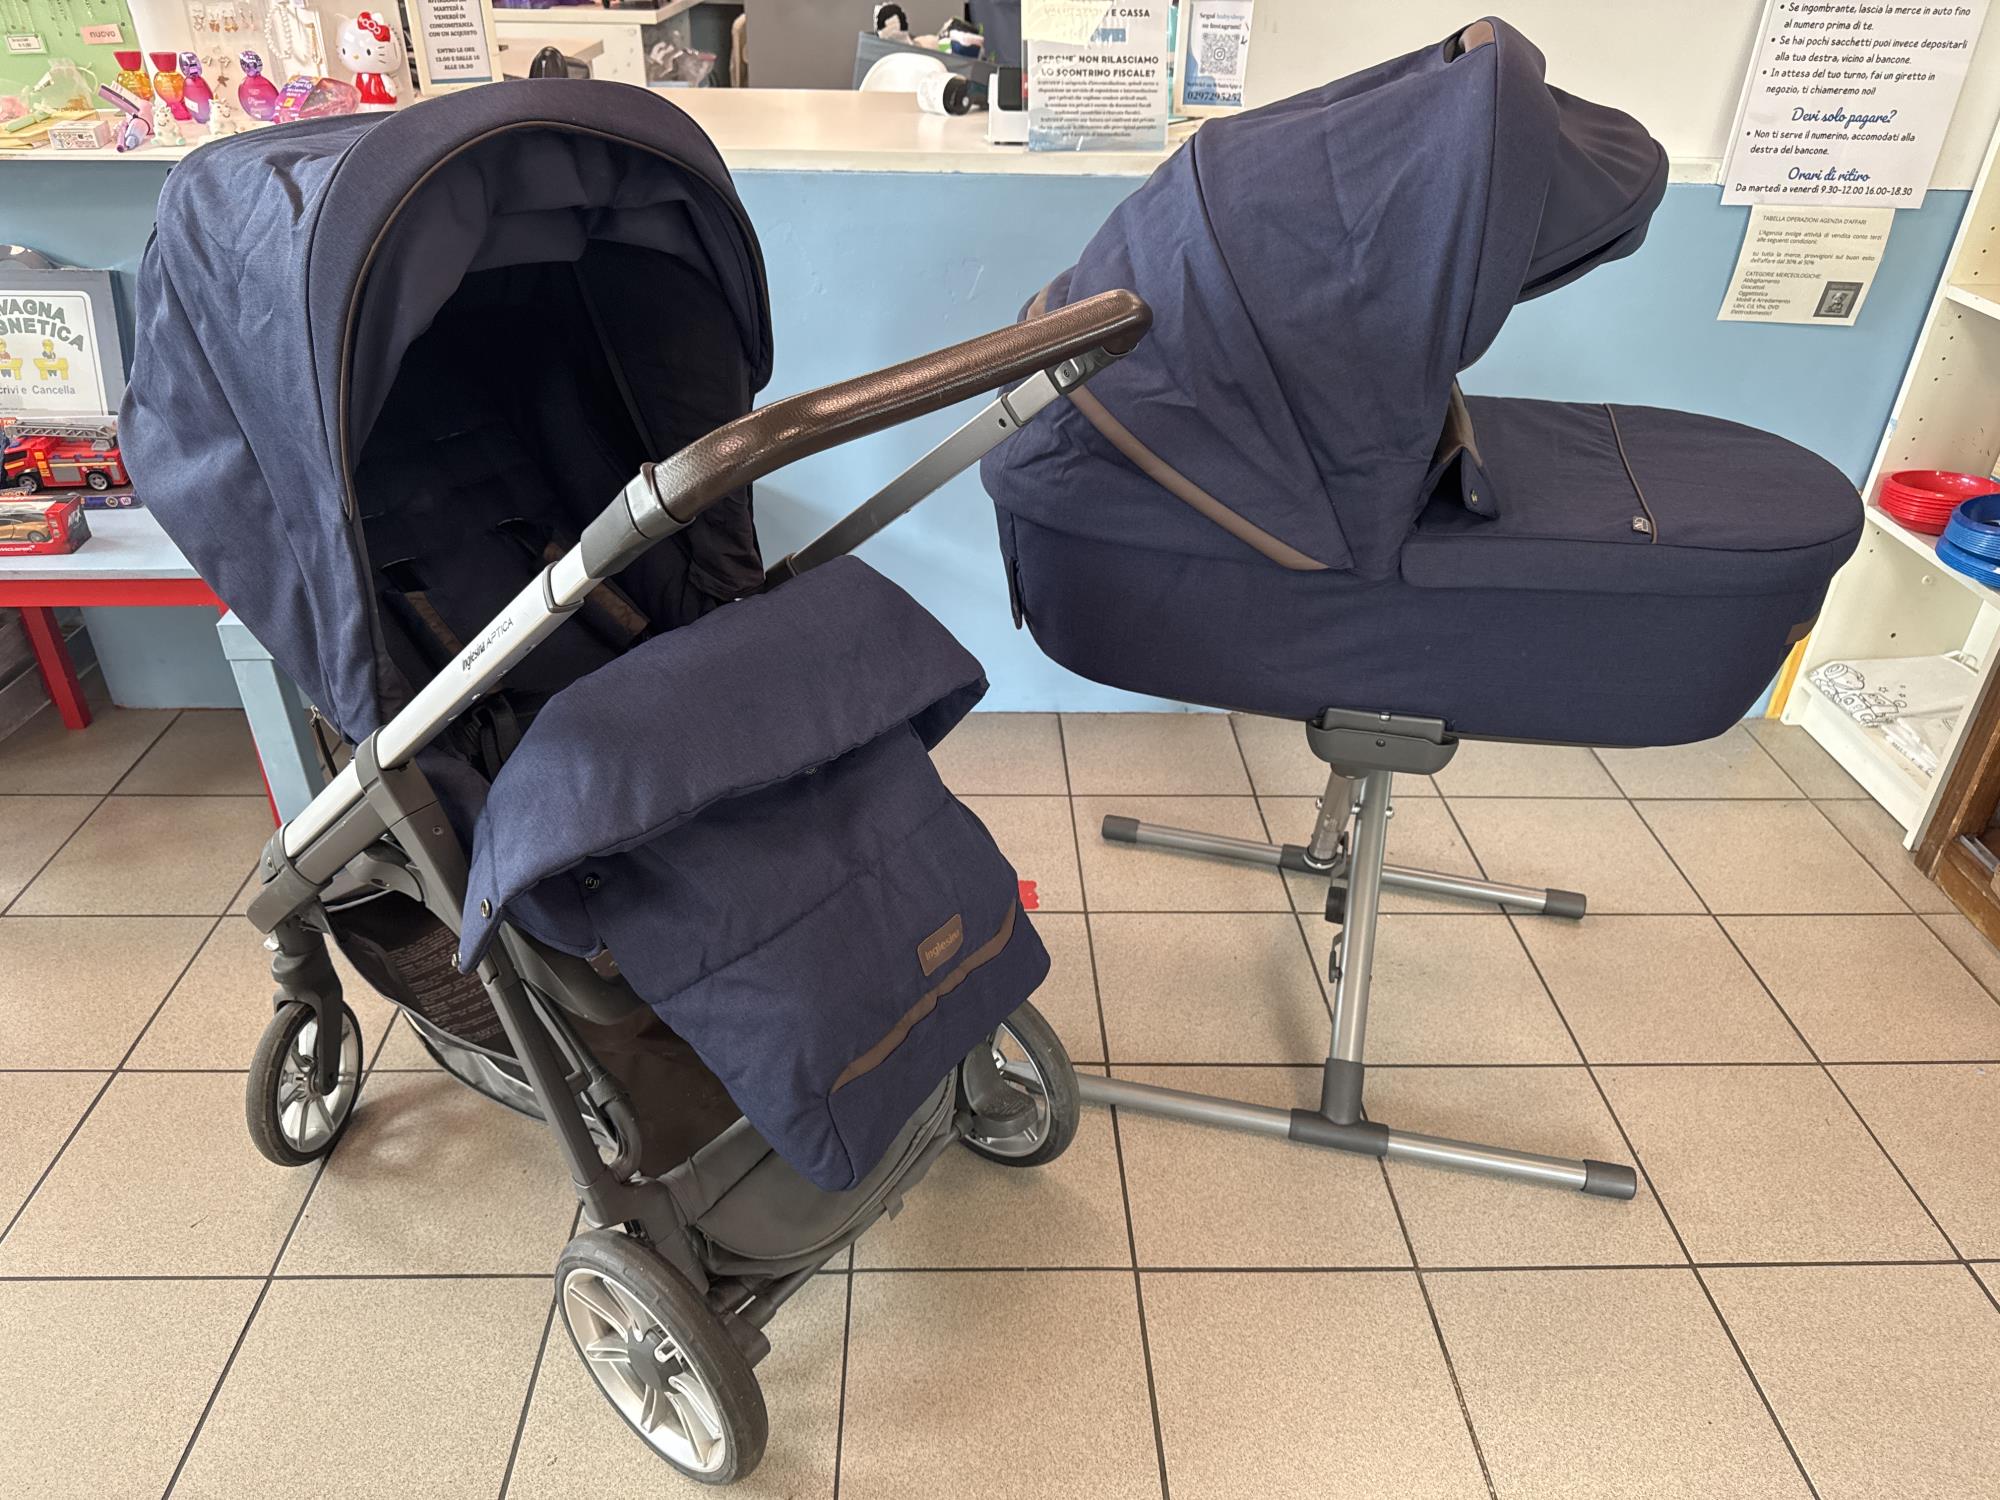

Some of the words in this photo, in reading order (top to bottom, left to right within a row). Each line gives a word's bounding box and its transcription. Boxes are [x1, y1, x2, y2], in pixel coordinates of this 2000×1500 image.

[1119, 9, 1150, 17] CASSA
[1788, 2, 1800, 12] Se
[1801, 3, 1857, 15] ingombrante,
[1859, 4, 1883, 14] lascia
[1885, 4, 1893, 14] la
[1894, 7, 1921, 15] merce
[1923, 6, 1930, 15] in
[1954, 6, 1971, 16] fino
[1784, 19, 1792, 28] al
[1793, 21, 1825, 29] numero
[1825, 22, 1851, 31] prima
[1852, 20, 1861, 30] di
[89, 30, 116, 38] nuovo
[1779, 35, 1790, 45] Se
[1792, 35, 1804, 45] hai
[1806, 36, 1829, 47] pochi
[1831, 37, 1872, 47] sacchetti
[1872, 39, 1891, 49] puoi
[1892, 40, 1919, 48] invece
[1920, 39, 1968, 50] depositarli
[1101, 56, 1159, 64] RILASCIAMO
[1775, 52, 1789, 61] alla
[1808, 53, 1839, 63] destra,
[1841, 54, 1864, 63] vicino
[1866, 53, 1875, 63] al
[1875, 54, 1912, 64] bancone.
[1041, 68, 1054, 76] LO
[1056, 69, 1110, 77] SCONTRINO
[1113, 69, 1156, 77] FISCALE?
[1770, 68, 1779, 77] In
[1781, 69, 1810, 78] attesa
[1812, 69, 1826, 78] del
[1843, 71, 1868, 79] turno,
[1870, 70, 1883, 79] fai
[1894, 72, 1926, 83] giretto
[1766, 85, 1799, 96] negozio,
[1810, 85, 1859, 95] chiameremo
[1861, 87, 1876, 95] noi!
[1791, 106, 1821, 122] Devi
[1821, 107, 1847, 122] solo
[1844, 110, 1897, 129] pagare?
[1754, 129, 1770, 138] Non
[1772, 130, 1779, 138] ti
[1805, 130, 1811, 139] il
[1811, 132, 1849, 141] numerino,
[1851, 132, 1900, 141] accomodati
[1901, 133, 1916, 141] alla
[1750, 145, 1778, 153] destra
[1780, 145, 1793, 154] del
[1794, 145, 1829, 155] bancone.
[1788, 166, 1822, 180] Orari
[1824, 166, 1836, 181] di
[1838, 168, 1870, 182] ritiro
[1735, 183, 1746, 192] Da
[1748, 184, 1781, 192] martedì
[1789, 185, 1819, 193] venerdì
[1820, 185, 1863, 194] 9.30-12.00
[1865, 186, 1912, 196] 16.00-18.30
[32, 385, 76, 394] Cancella
[486, 617, 514, 648] APTICA
